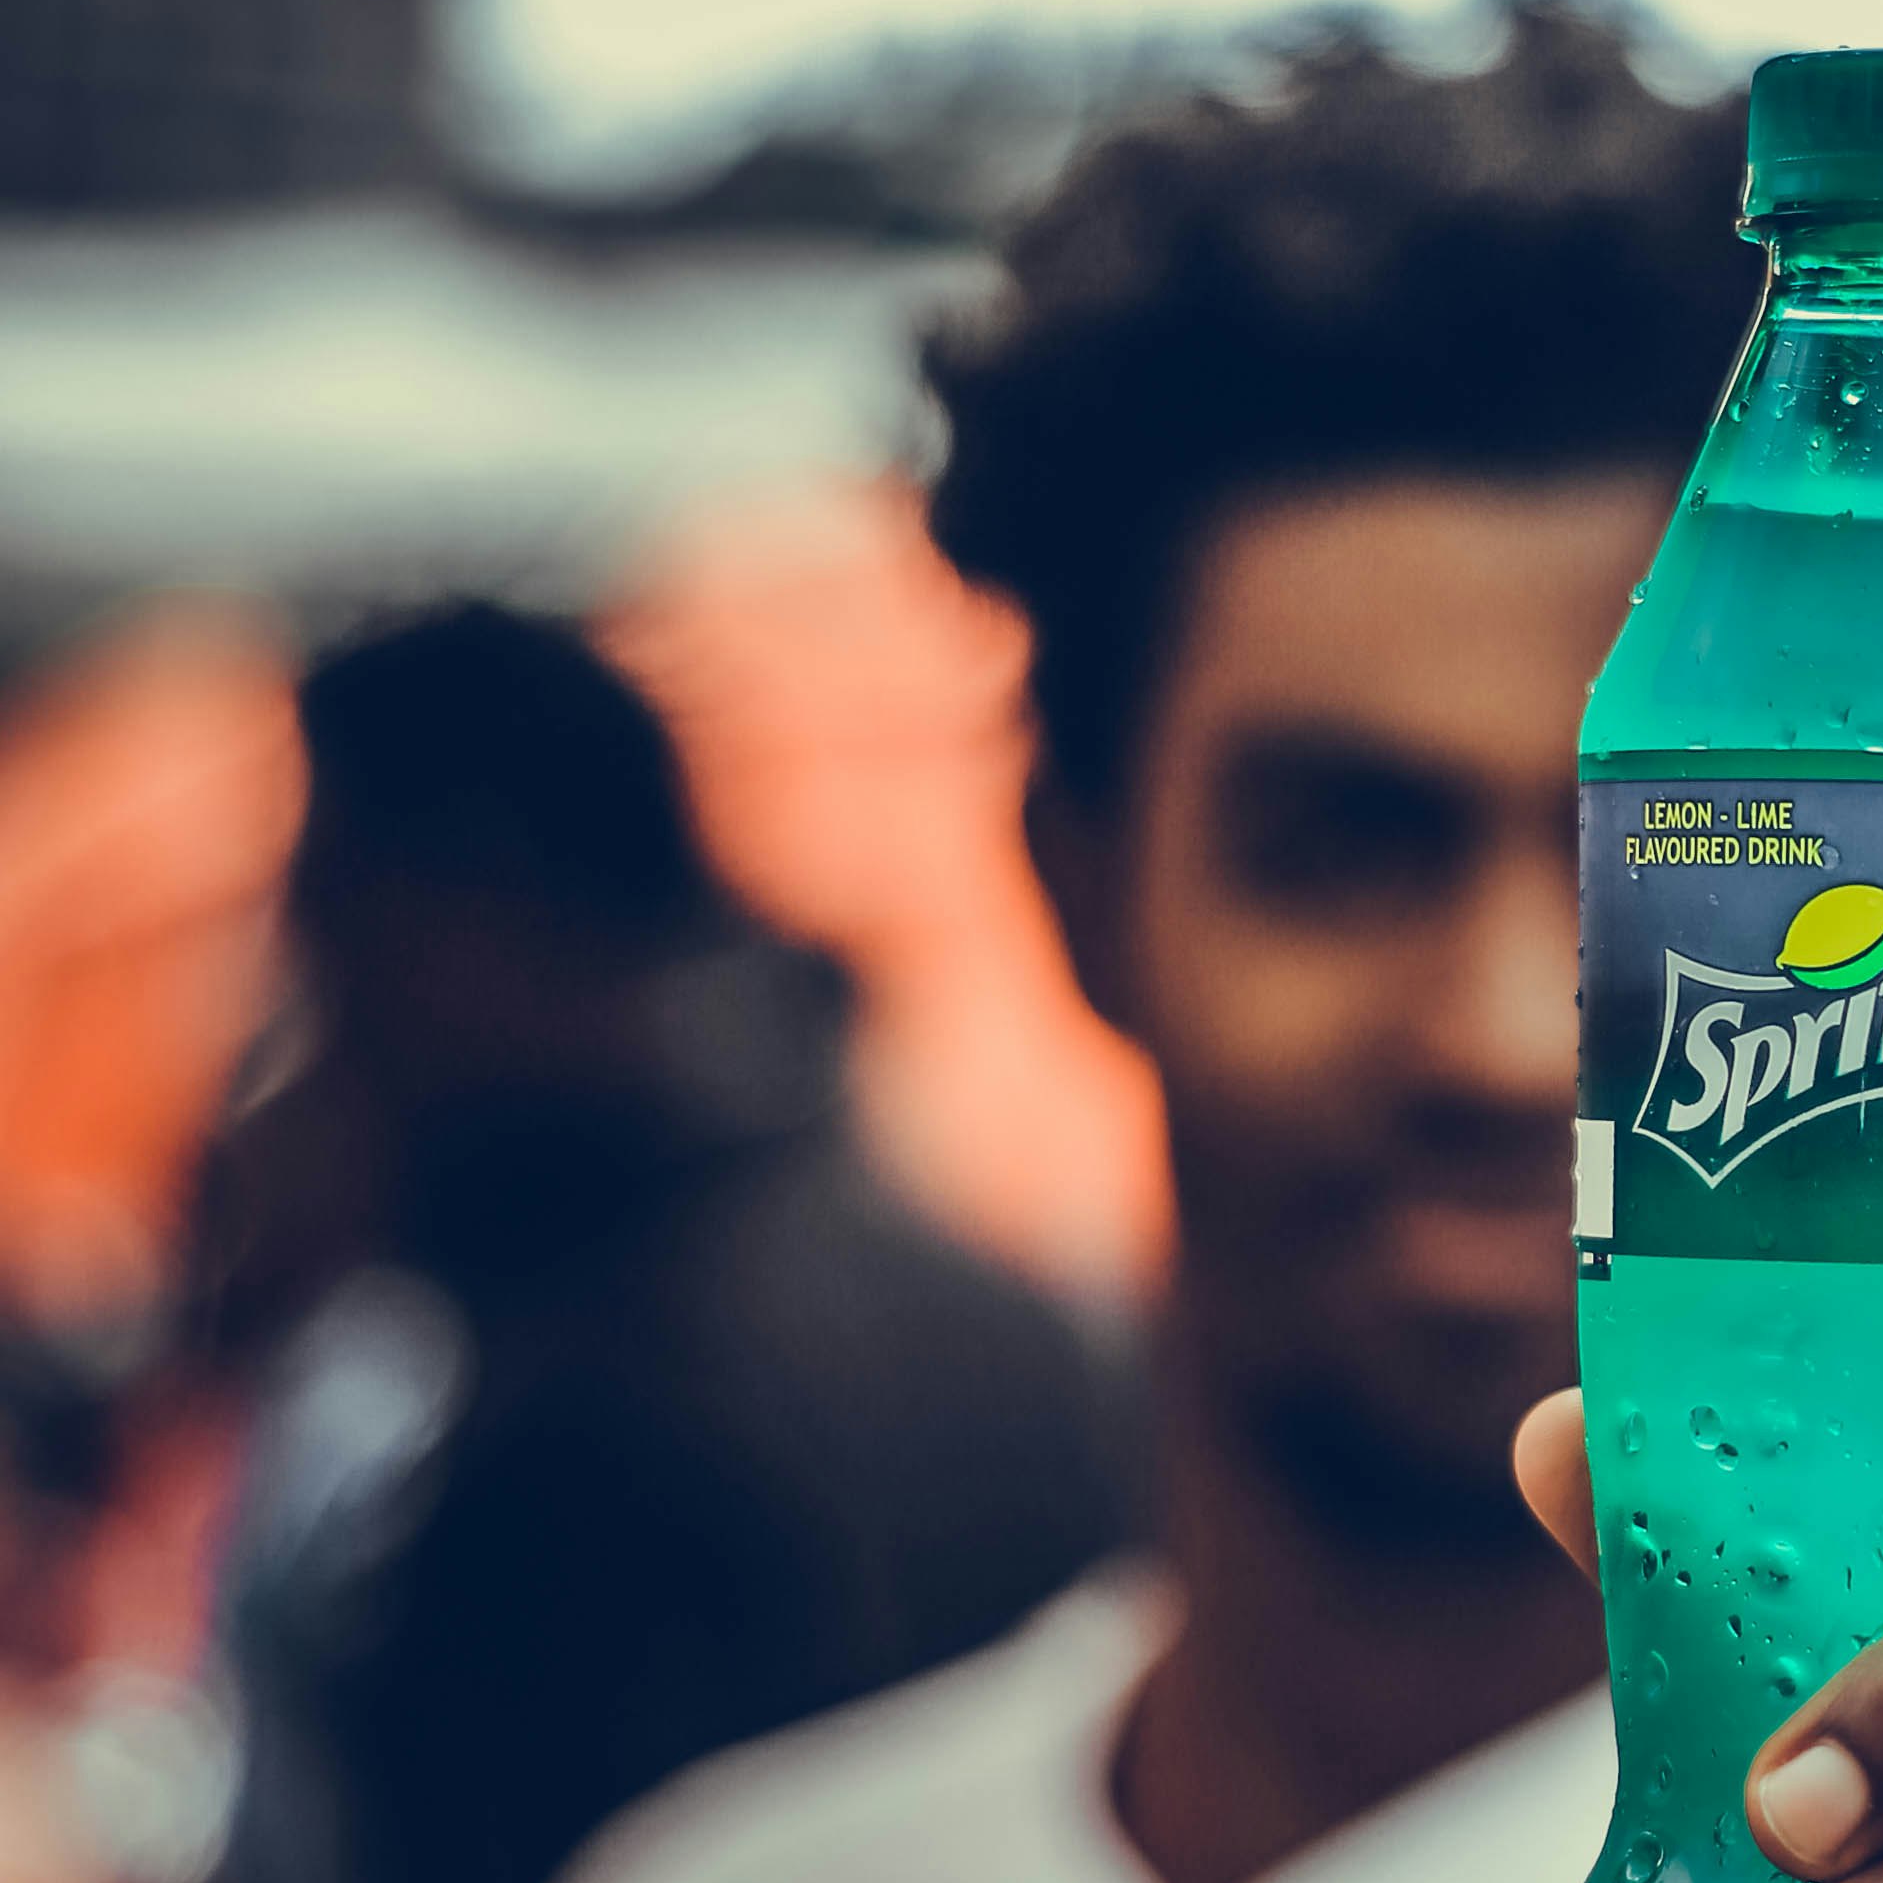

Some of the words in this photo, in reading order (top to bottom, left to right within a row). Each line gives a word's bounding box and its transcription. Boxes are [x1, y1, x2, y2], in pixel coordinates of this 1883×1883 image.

[1644, 801, 1712, 830] LEMON
[1736, 801, 1793, 830] LIME
[1625, 836, 1740, 865] FLAVOURED
[1747, 836, 1824, 868] DRINK
